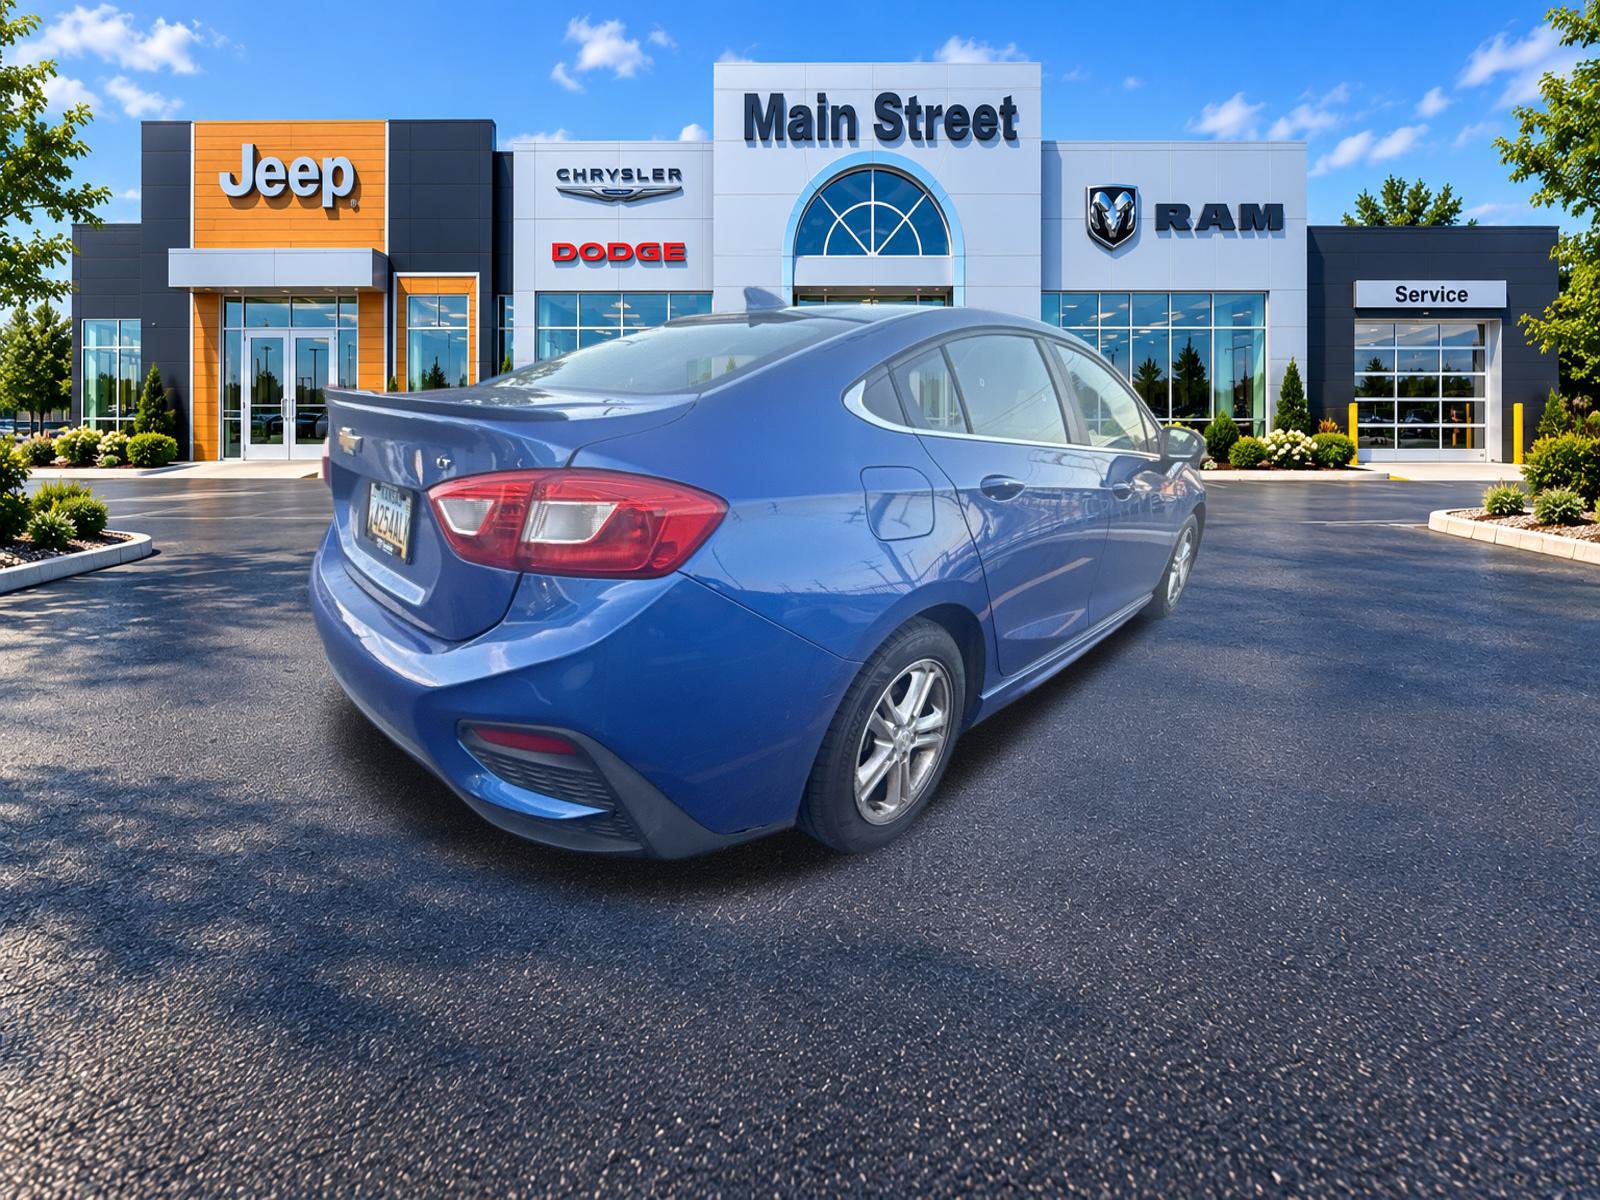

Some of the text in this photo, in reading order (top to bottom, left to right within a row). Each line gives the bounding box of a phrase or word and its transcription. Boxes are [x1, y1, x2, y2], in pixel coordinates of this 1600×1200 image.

[744, 91, 1018, 142] Main Street
[218, 143, 356, 209] Jeep
[556, 167, 683, 182] CHRYSLER
[1154, 203, 1284, 232] RAM
[551, 242, 687, 263] DODGE
[1395, 285, 1469, 303] Service
